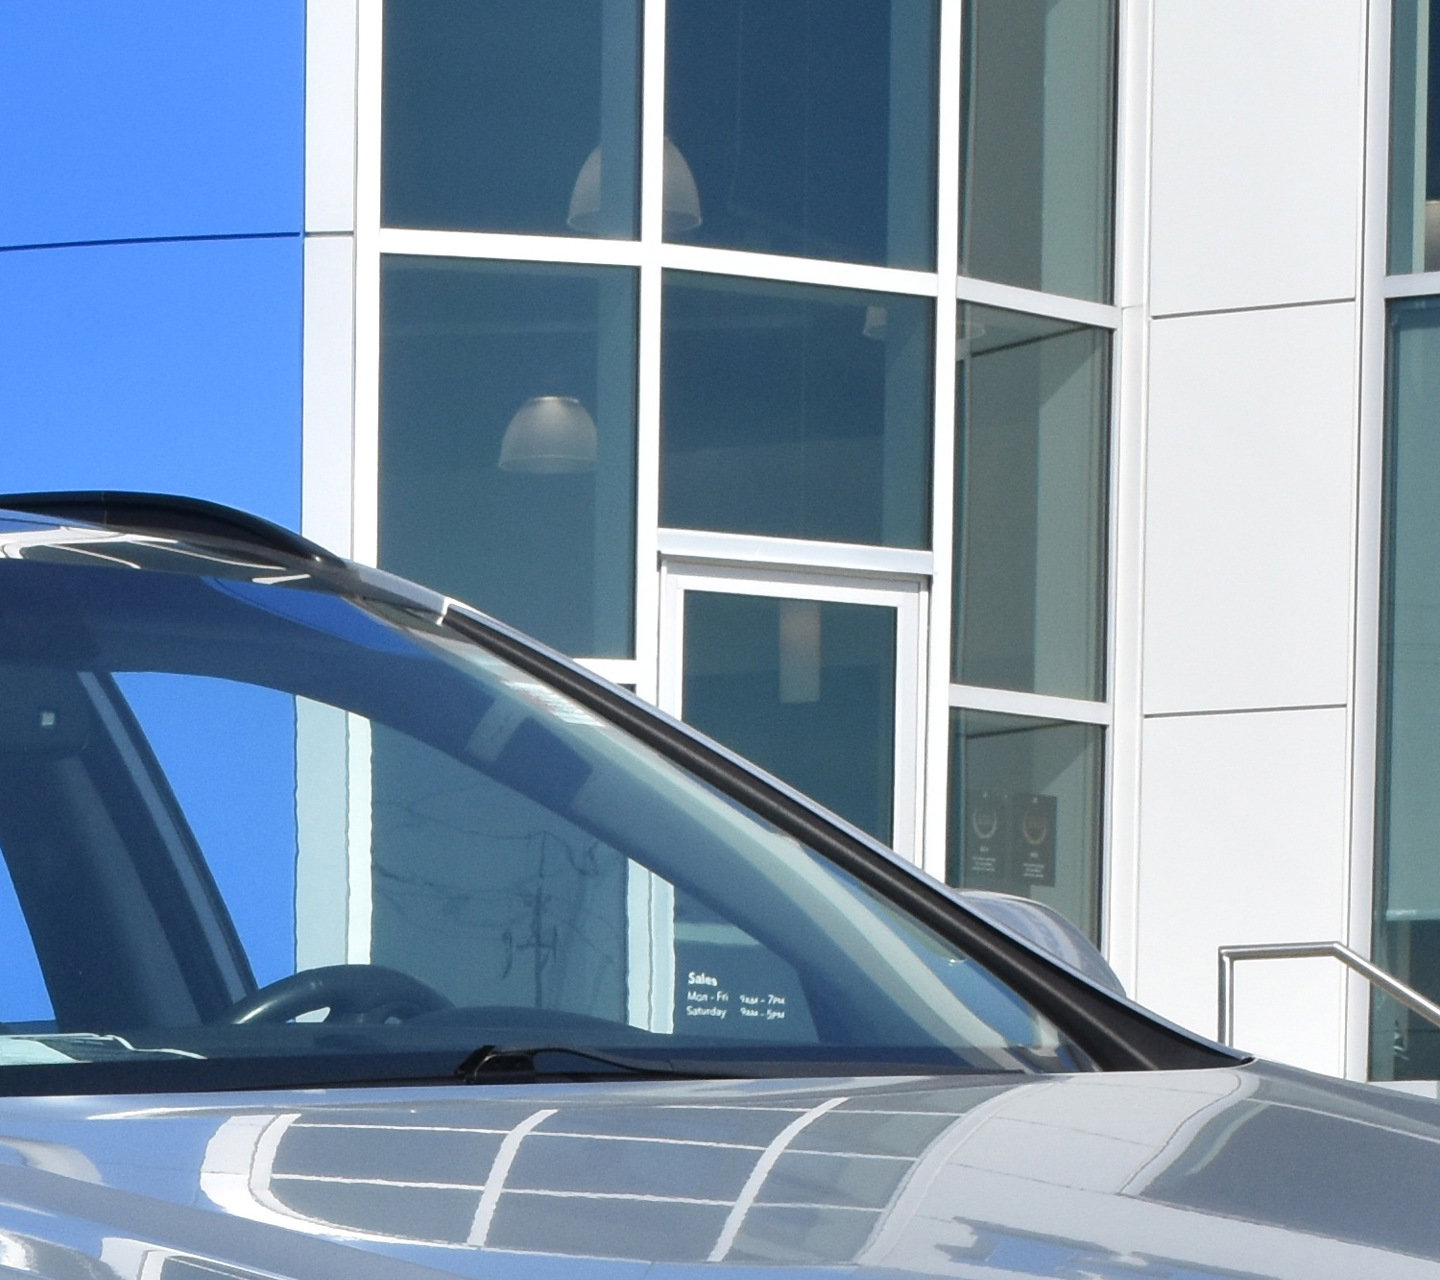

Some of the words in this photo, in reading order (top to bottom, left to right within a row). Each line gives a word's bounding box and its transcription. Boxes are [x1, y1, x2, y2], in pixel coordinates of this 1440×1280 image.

[687, 971, 718, 986] Sales
[687, 991, 708, 1002] Mon
[716, 990, 729, 1002] Fri
[686, 1005, 727, 1020] Saturday
